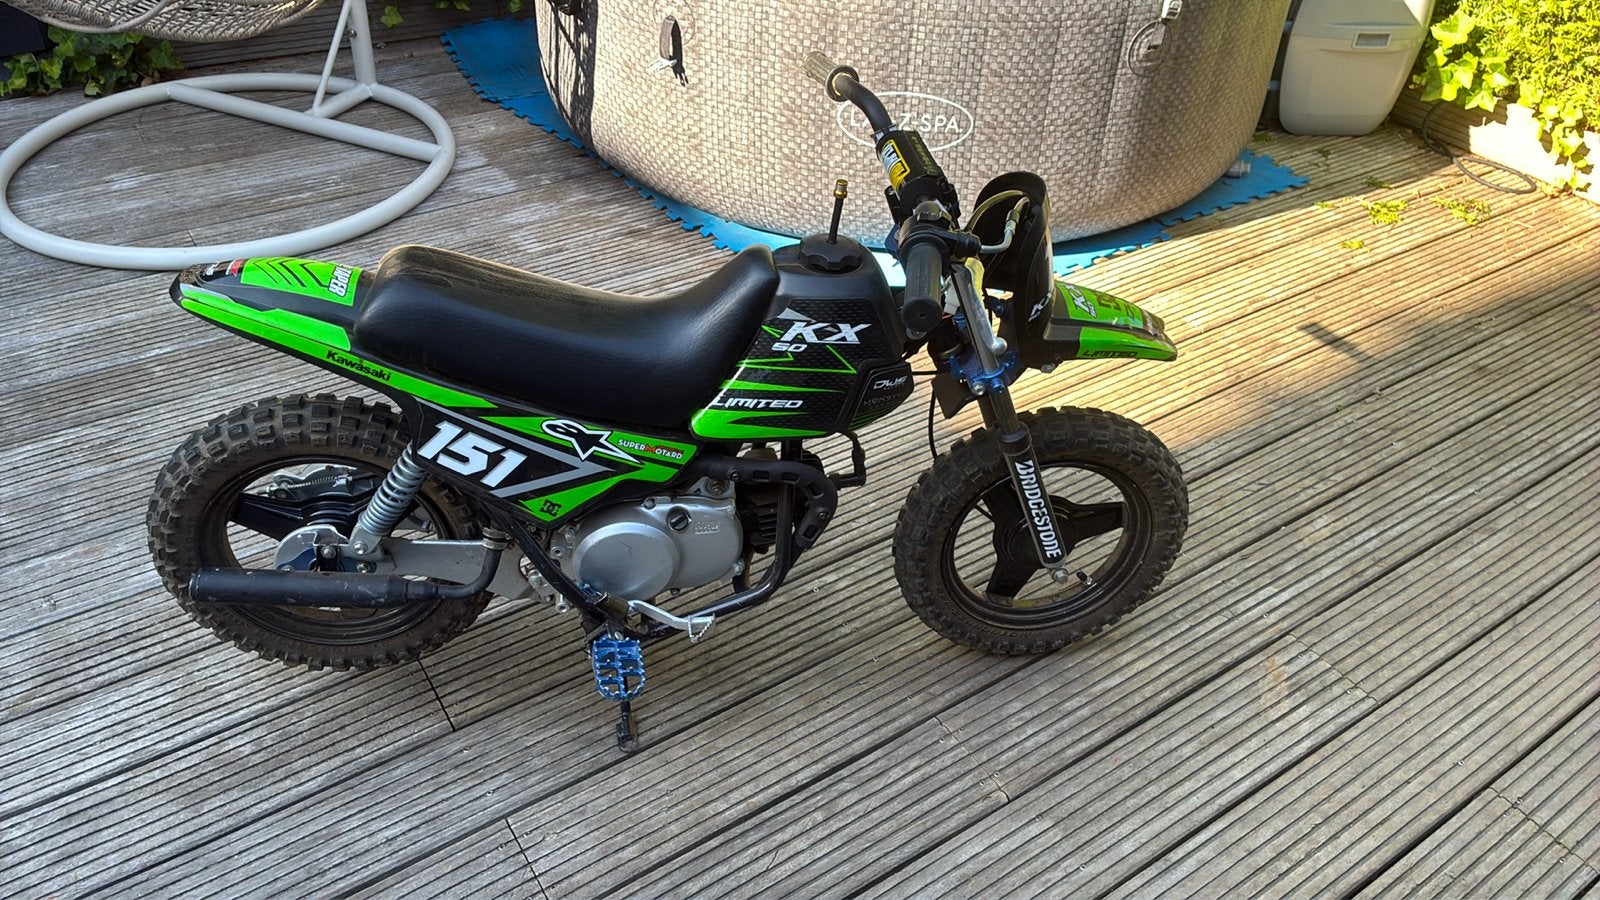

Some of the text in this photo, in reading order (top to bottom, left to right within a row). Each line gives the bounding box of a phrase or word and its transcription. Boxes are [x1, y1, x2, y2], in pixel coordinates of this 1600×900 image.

[780, 321, 872, 345] KX
[771, 342, 808, 352] 50
[325, 350, 392, 382] Kawasaki
[711, 396, 804, 409] LIMITED
[417, 420, 528, 488] 151
[618, 439, 684, 460] SUPERMOTARD
[1015, 460, 1062, 558] BRIDGESTONE
